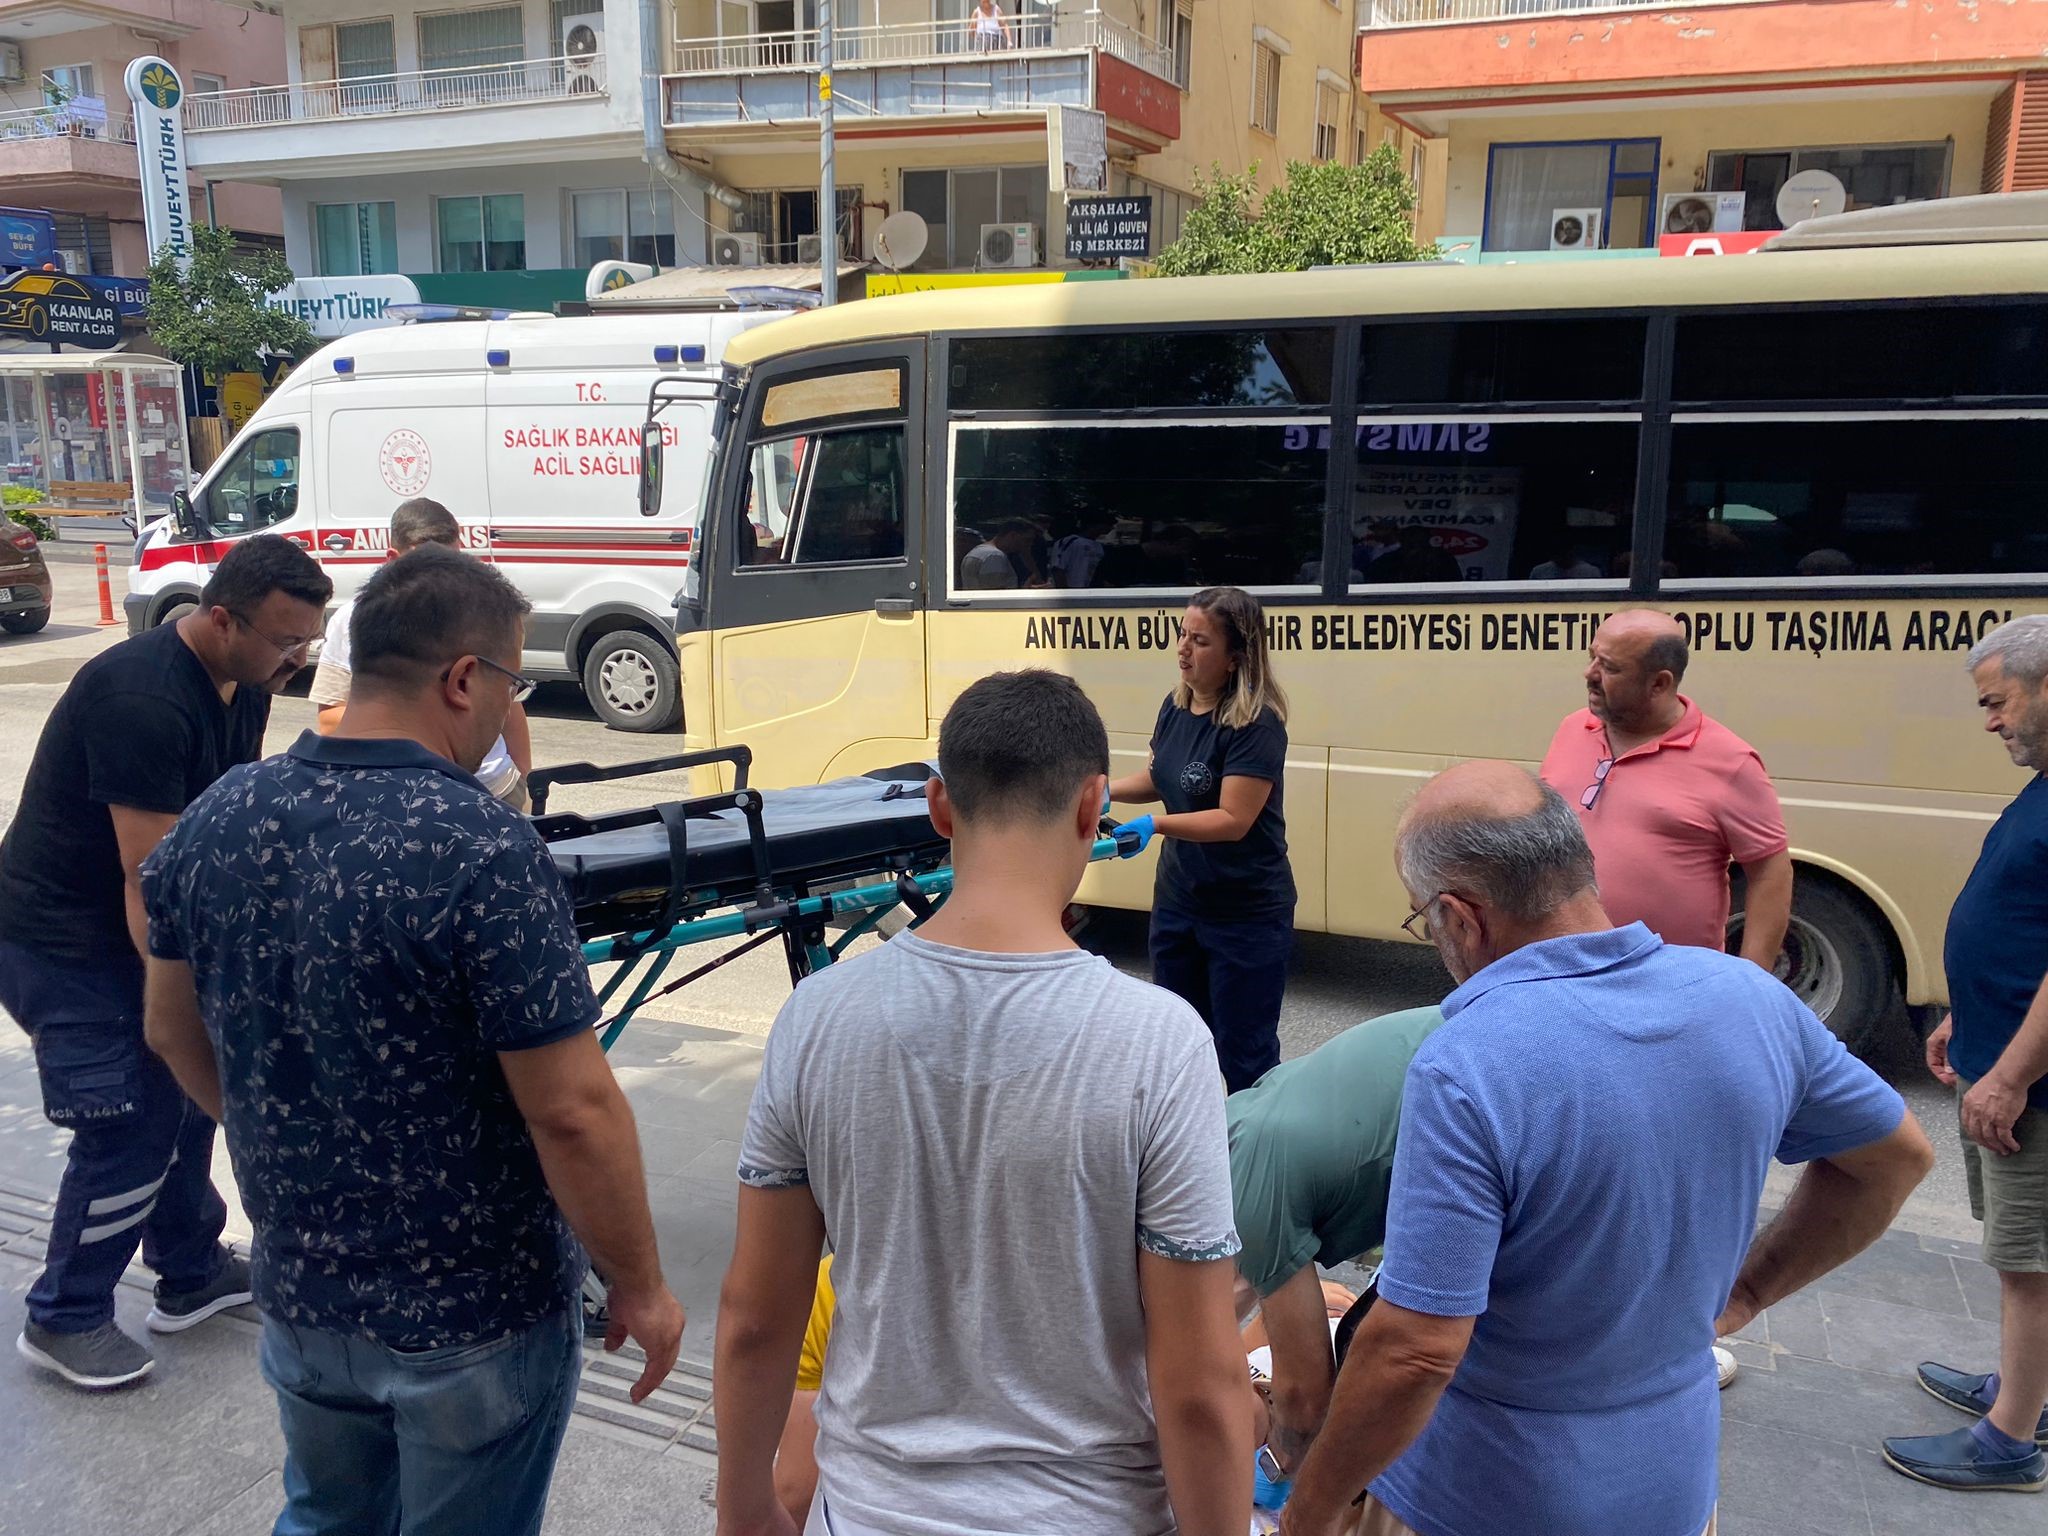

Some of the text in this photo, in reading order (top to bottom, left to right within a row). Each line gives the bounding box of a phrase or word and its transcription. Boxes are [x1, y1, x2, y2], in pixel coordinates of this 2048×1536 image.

[1087, 236, 1145, 252] MERKEZİ
[50, 303, 114, 322] KAANLAR
[51, 320, 115, 336] RENT A CAR
[576, 383, 607, 402] T.C.
[504, 422, 680, 448] SAĞLIK BAKANĞI
[533, 452, 574, 476] ACİL
[1025, 615, 1130, 650] ANTALYA
[1766, 610, 1892, 659] TAŞIMA
